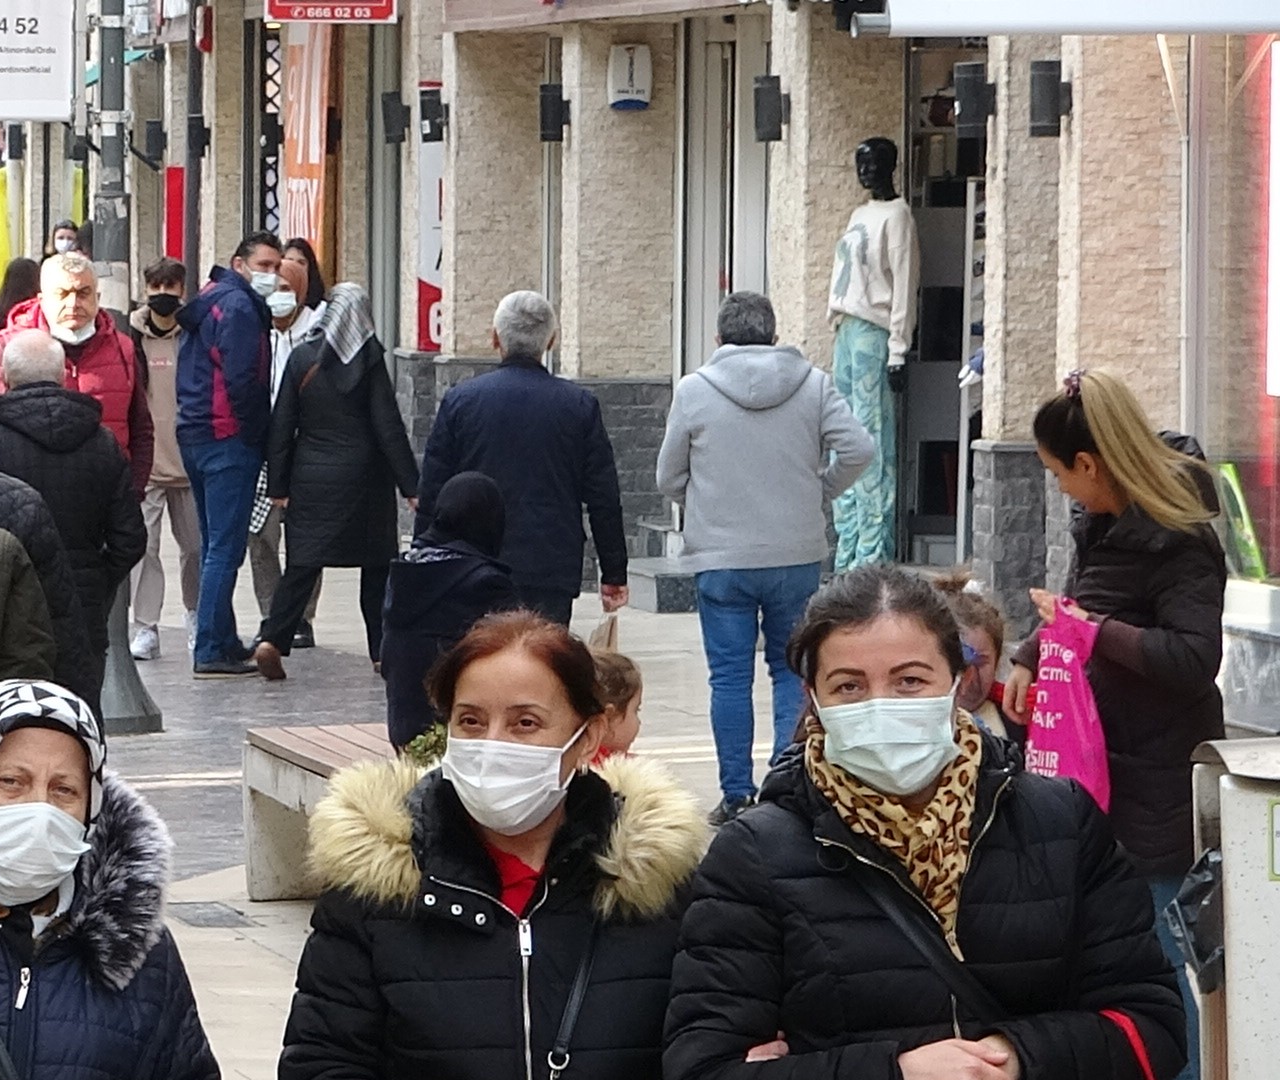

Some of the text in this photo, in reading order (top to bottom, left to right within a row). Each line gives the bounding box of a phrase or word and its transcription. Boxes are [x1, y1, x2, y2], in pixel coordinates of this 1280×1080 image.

[306, 8, 371, 18] 666 02 03
[15, 17, 39, 35] 52
